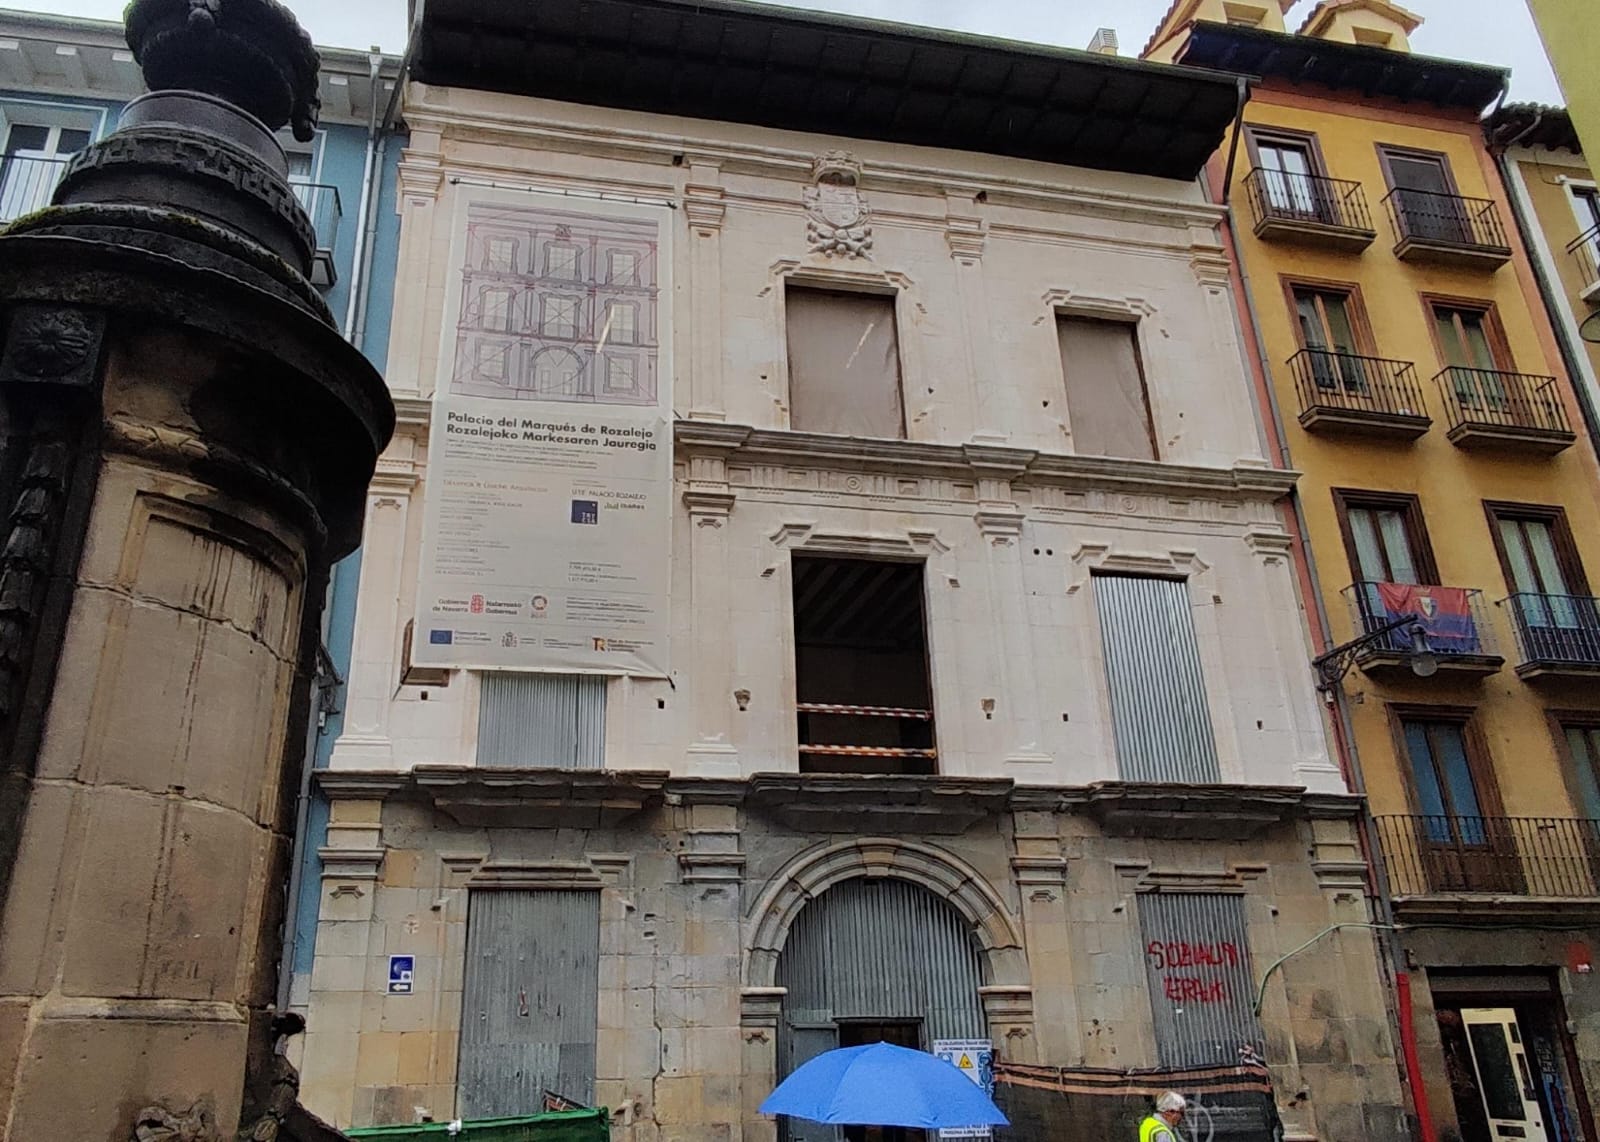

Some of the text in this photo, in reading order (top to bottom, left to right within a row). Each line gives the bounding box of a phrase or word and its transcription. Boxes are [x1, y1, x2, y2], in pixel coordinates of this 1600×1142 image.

[447, 424, 518, 441] Rozalejoko
[522, 431, 599, 446] Markesaren
[602, 438, 657, 451] Jauregia
[448, 412, 653, 440] Palacio del Marqués de Rozalejo
[588, 490, 615, 498] PALACIO
[616, 492, 647, 500] ROZALEJO
